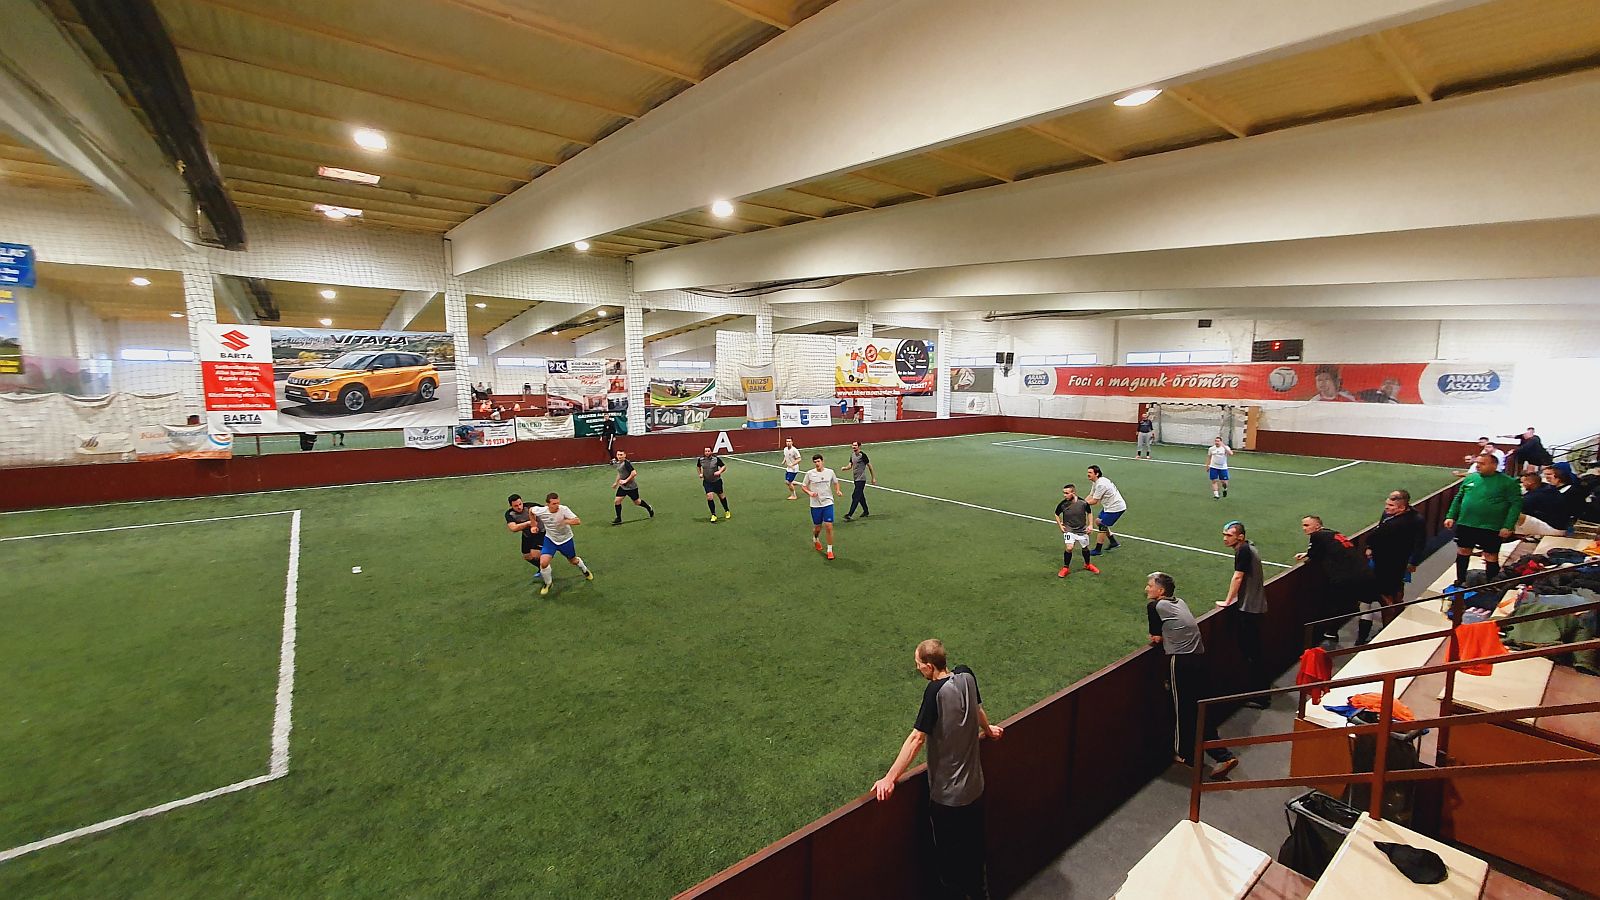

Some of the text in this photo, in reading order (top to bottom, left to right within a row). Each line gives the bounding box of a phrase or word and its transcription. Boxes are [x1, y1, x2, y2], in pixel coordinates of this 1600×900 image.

[331, 335, 409, 346] VITARA
[1067, 372, 1240, 392] Foci a magunk örömére
[1446, 374, 1493, 383] ARANY
[223, 414, 262, 422] BARTA
[654, 408, 682, 424] Fair
[408, 434, 446, 442] EMERSON
[712, 431, 734, 454] A
